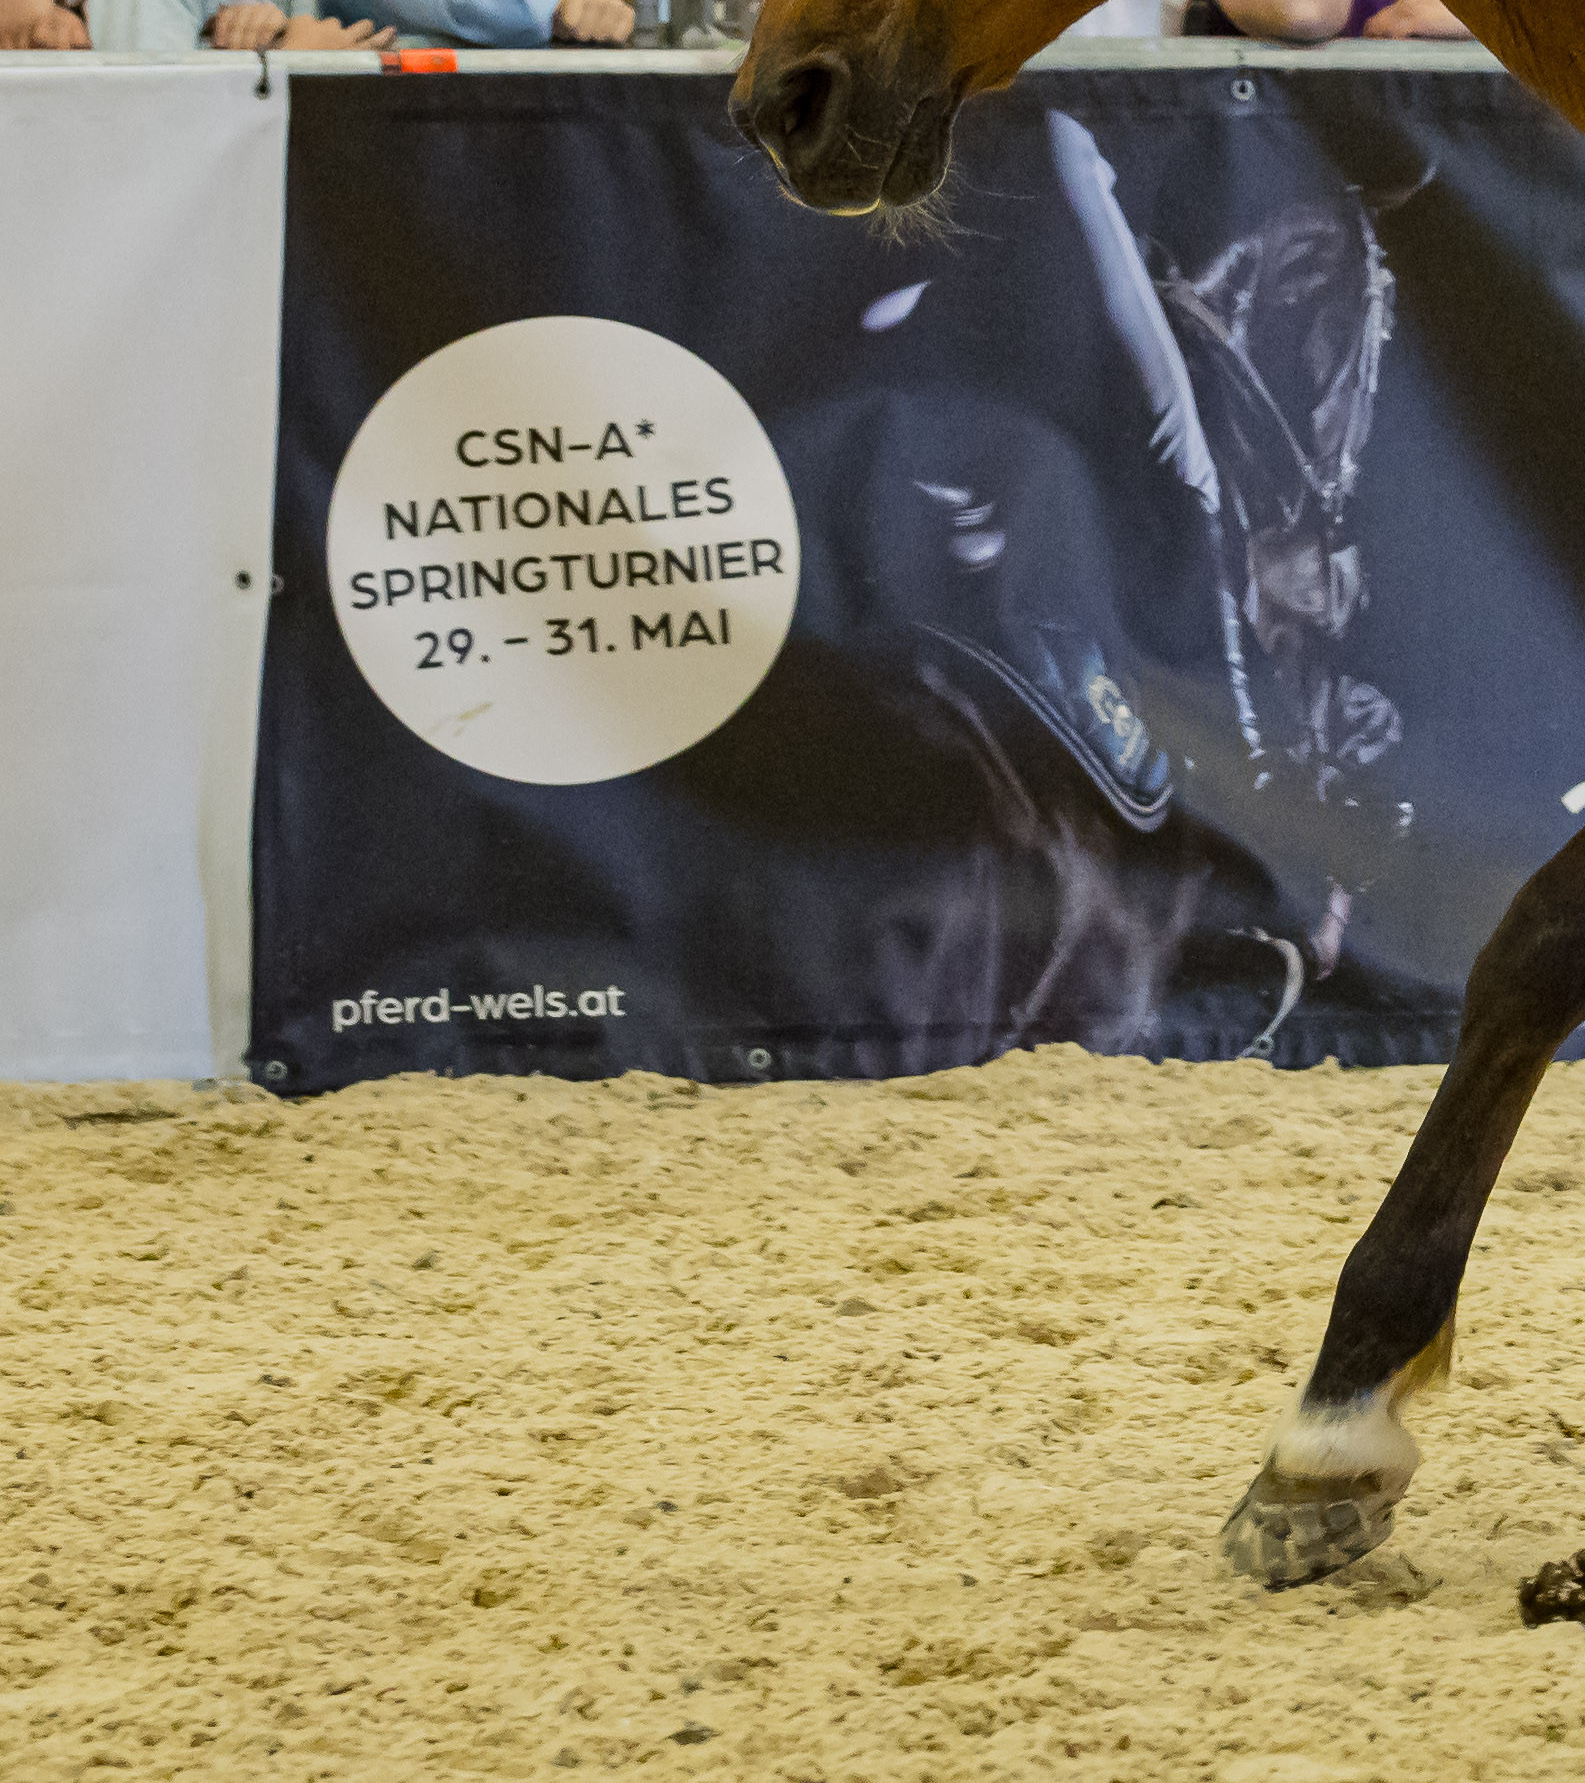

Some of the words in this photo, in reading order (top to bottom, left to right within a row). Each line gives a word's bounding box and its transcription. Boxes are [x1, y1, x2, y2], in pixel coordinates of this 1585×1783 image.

[383, 475, 736, 540] NATIONALES
[349, 537, 784, 611] SPRINGTURNIER
[415, 627, 491, 671] 29.
[545, 615, 618, 657] 31.
[629, 608, 732, 651] MAI
[331, 983, 628, 1034] pferd-wels.at
